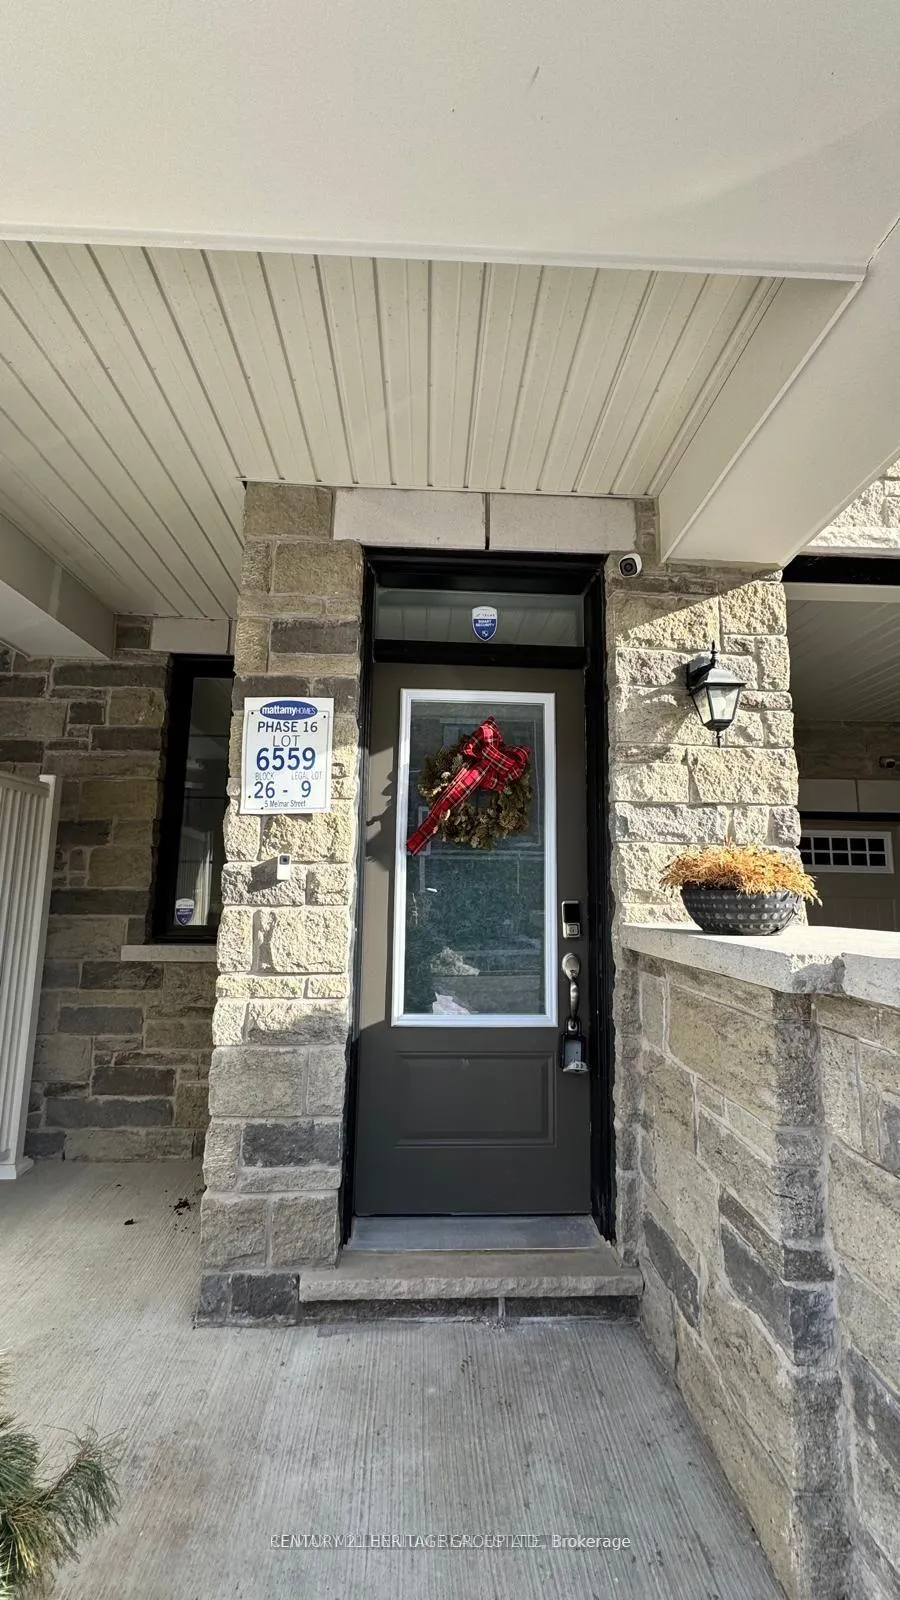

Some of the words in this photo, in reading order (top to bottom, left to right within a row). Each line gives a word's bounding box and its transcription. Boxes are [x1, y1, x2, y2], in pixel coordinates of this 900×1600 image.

[257, 721, 299, 733] PHASE
[303, 721, 318, 733] 16
[272, 735, 301, 747] LOT
[256, 747, 316, 771] 6559
[255, 772, 275, 781] BLOCK
[291, 771, 309, 780] LEGAL
[311, 771, 322, 780] LOT
[254, 781, 276, 799] 26
[301, 780, 312, 798] 9
[264, 800, 269, 808] 5
[290, 799, 306, 808] Street
